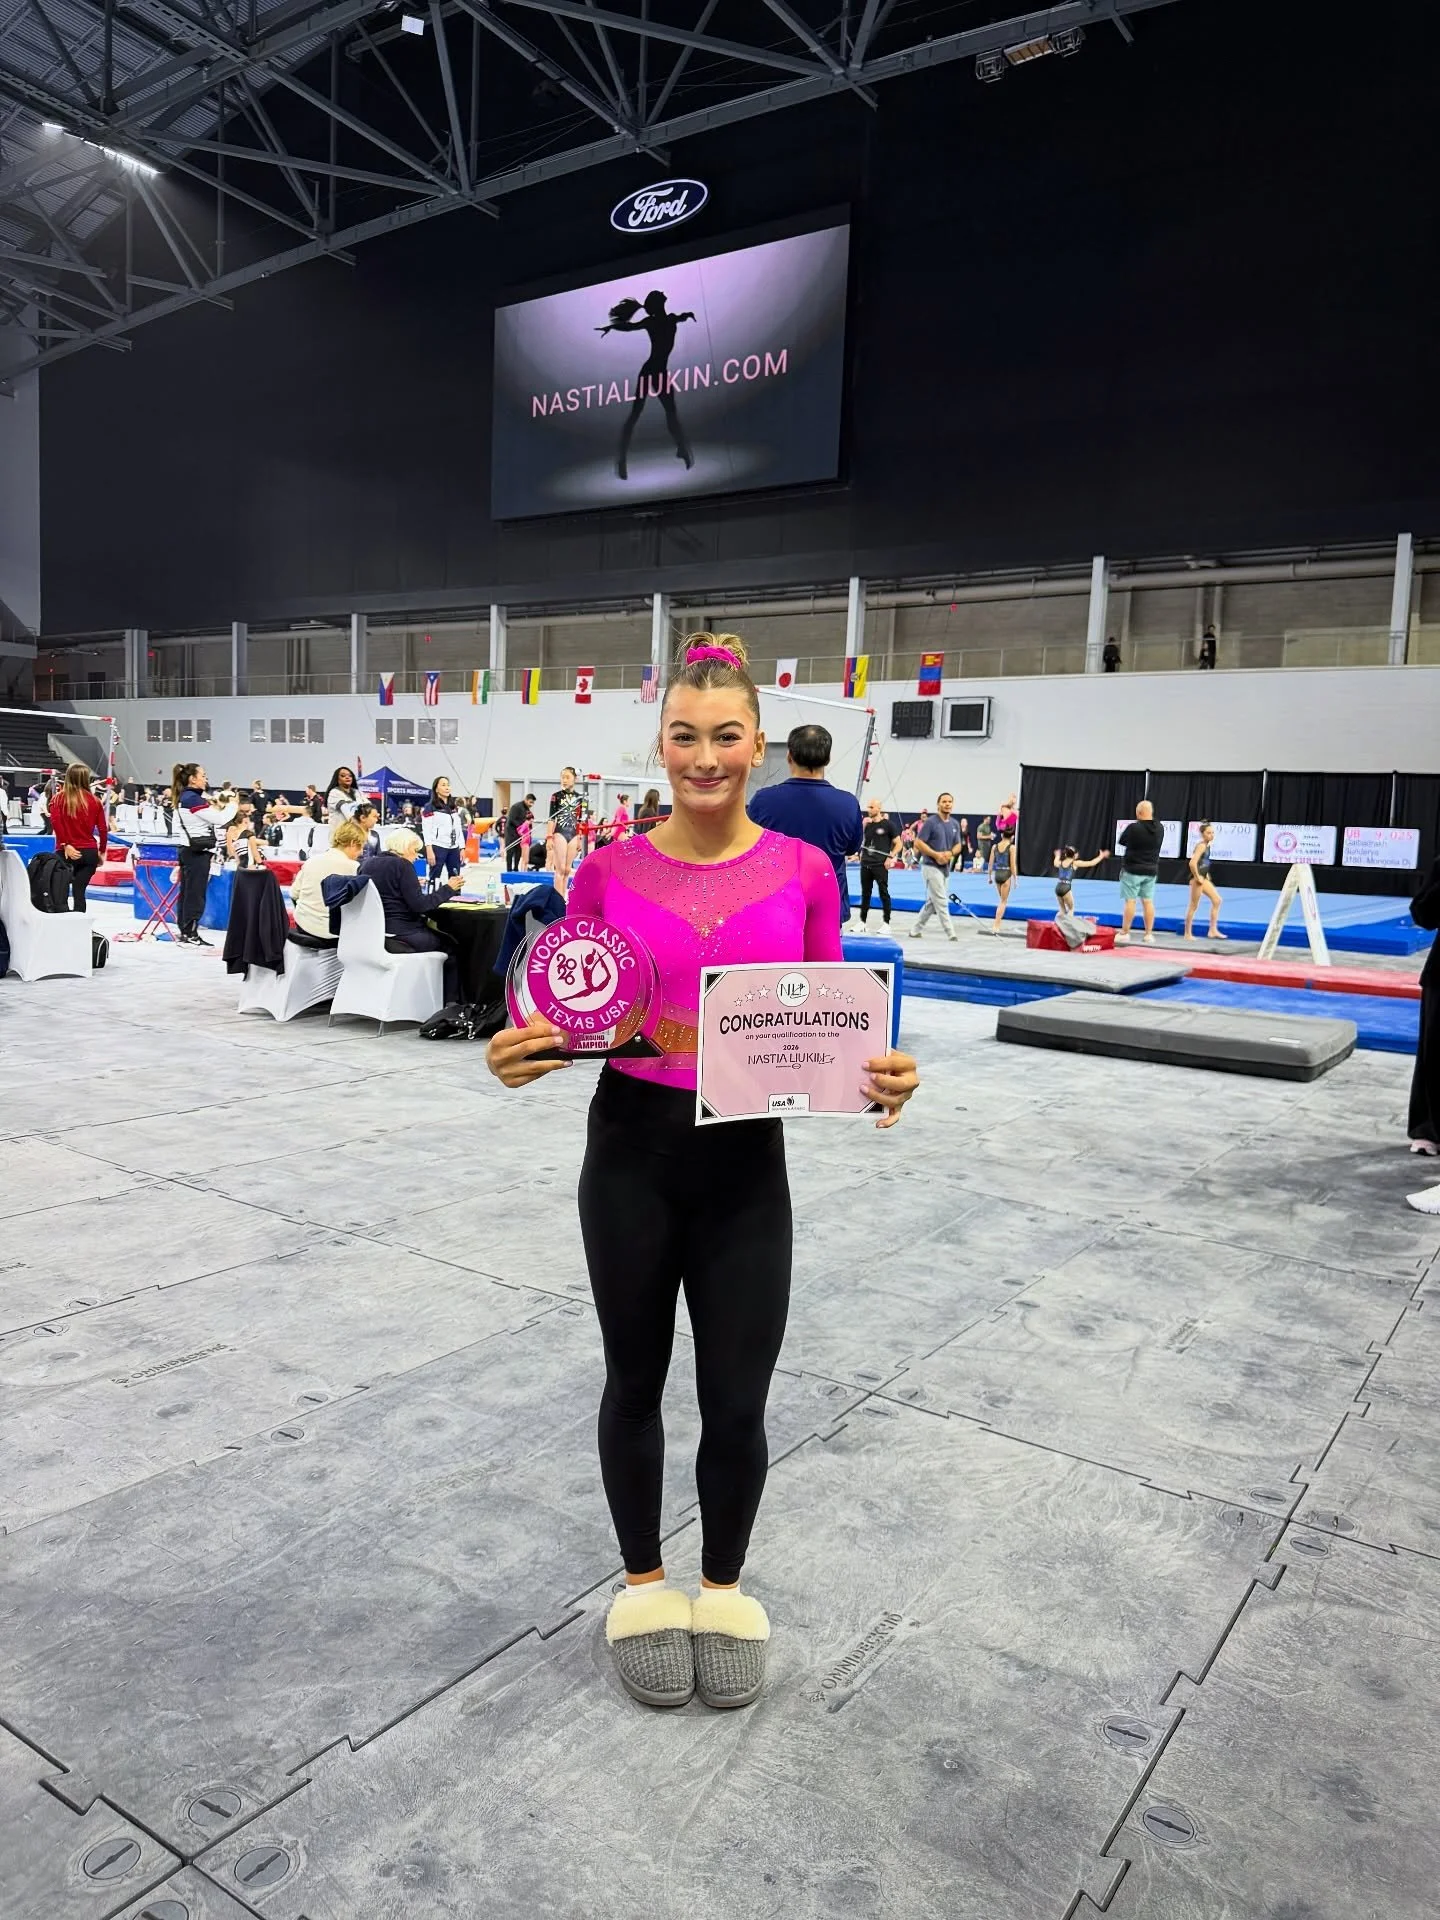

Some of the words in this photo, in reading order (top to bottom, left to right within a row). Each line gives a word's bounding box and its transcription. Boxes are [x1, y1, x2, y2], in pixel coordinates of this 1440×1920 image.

[628, 187, 689, 227] Ford
[532, 349, 788, 418] NASTIALIUKIN.COM
[530, 926, 572, 974] WOGA
[576, 921, 635, 971] CLASSIC
[546, 1002, 595, 1029] TEXAS
[600, 999, 630, 1025] USA
[719, 1011, 870, 1035] CONGRATULATIONS
[748, 1053, 788, 1065] NASTIA
